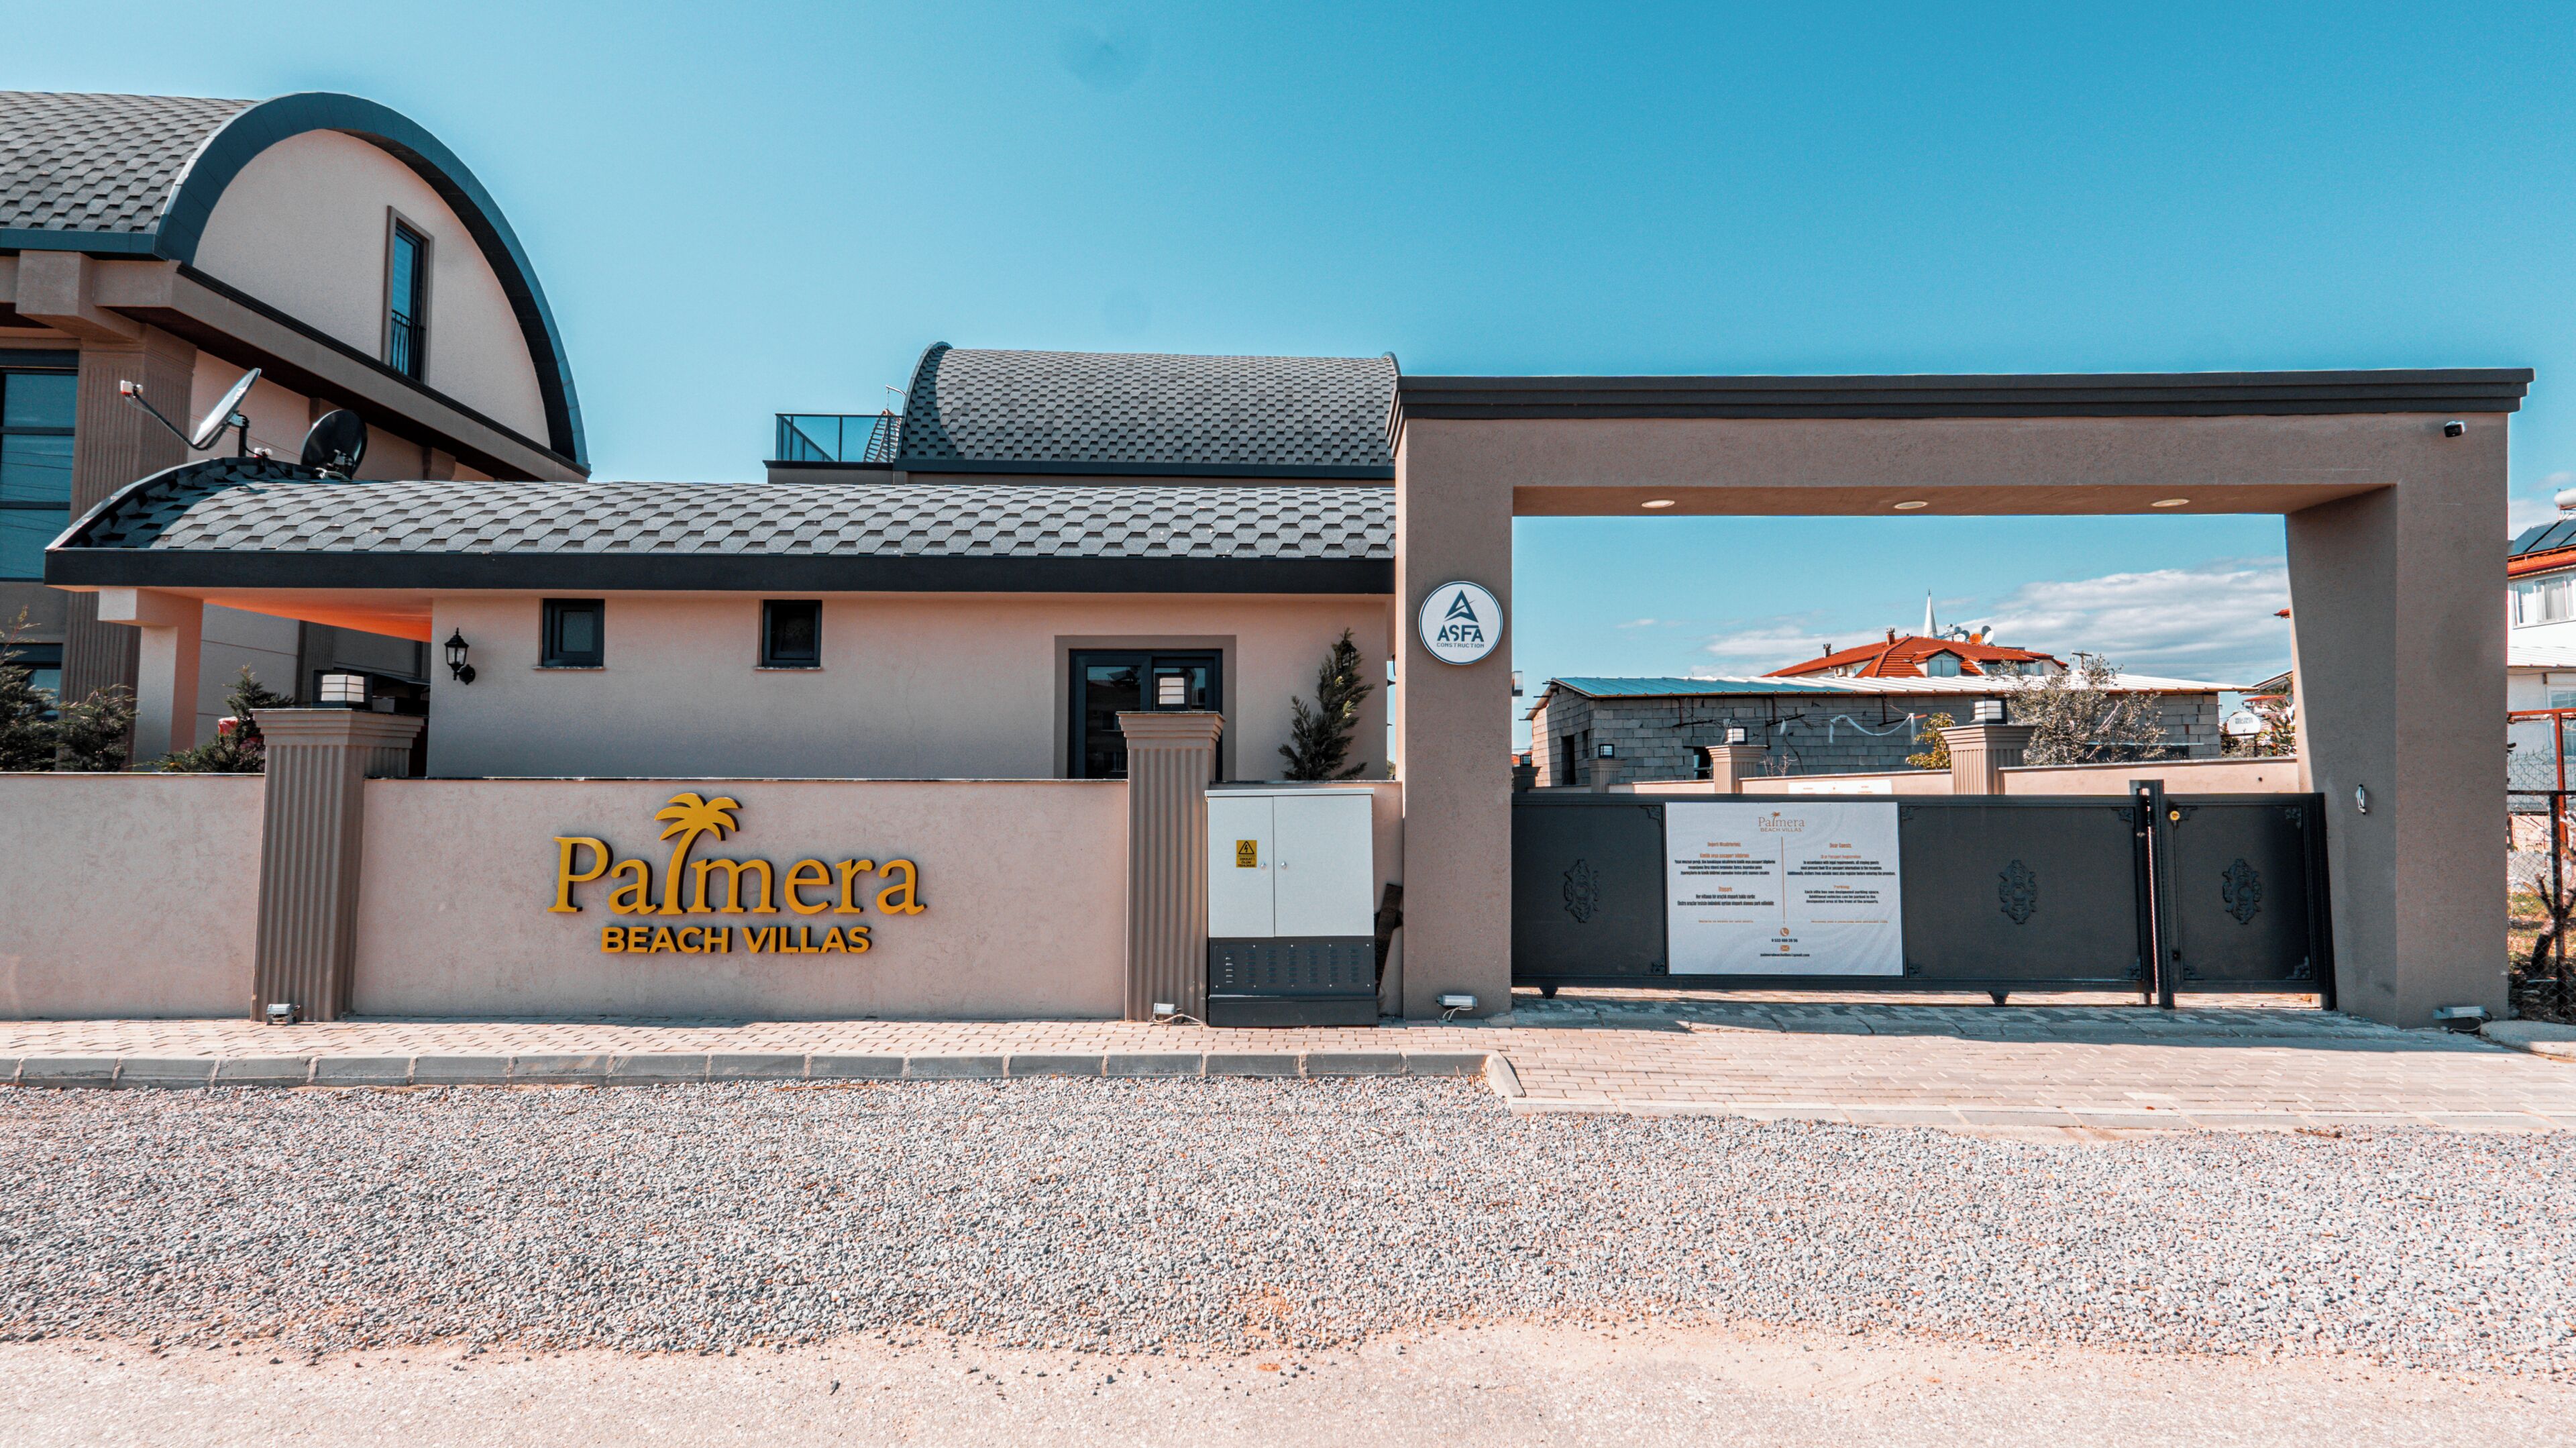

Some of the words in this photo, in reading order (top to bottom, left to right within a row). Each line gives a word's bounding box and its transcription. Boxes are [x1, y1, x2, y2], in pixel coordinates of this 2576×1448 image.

[1437, 624, 1484, 642] ASFA
[1758, 811, 1805, 827] Palmera
[547, 792, 928, 915] Palmera
[601, 926, 733, 953] BEACH
[742, 926, 872, 953] VILLAS
